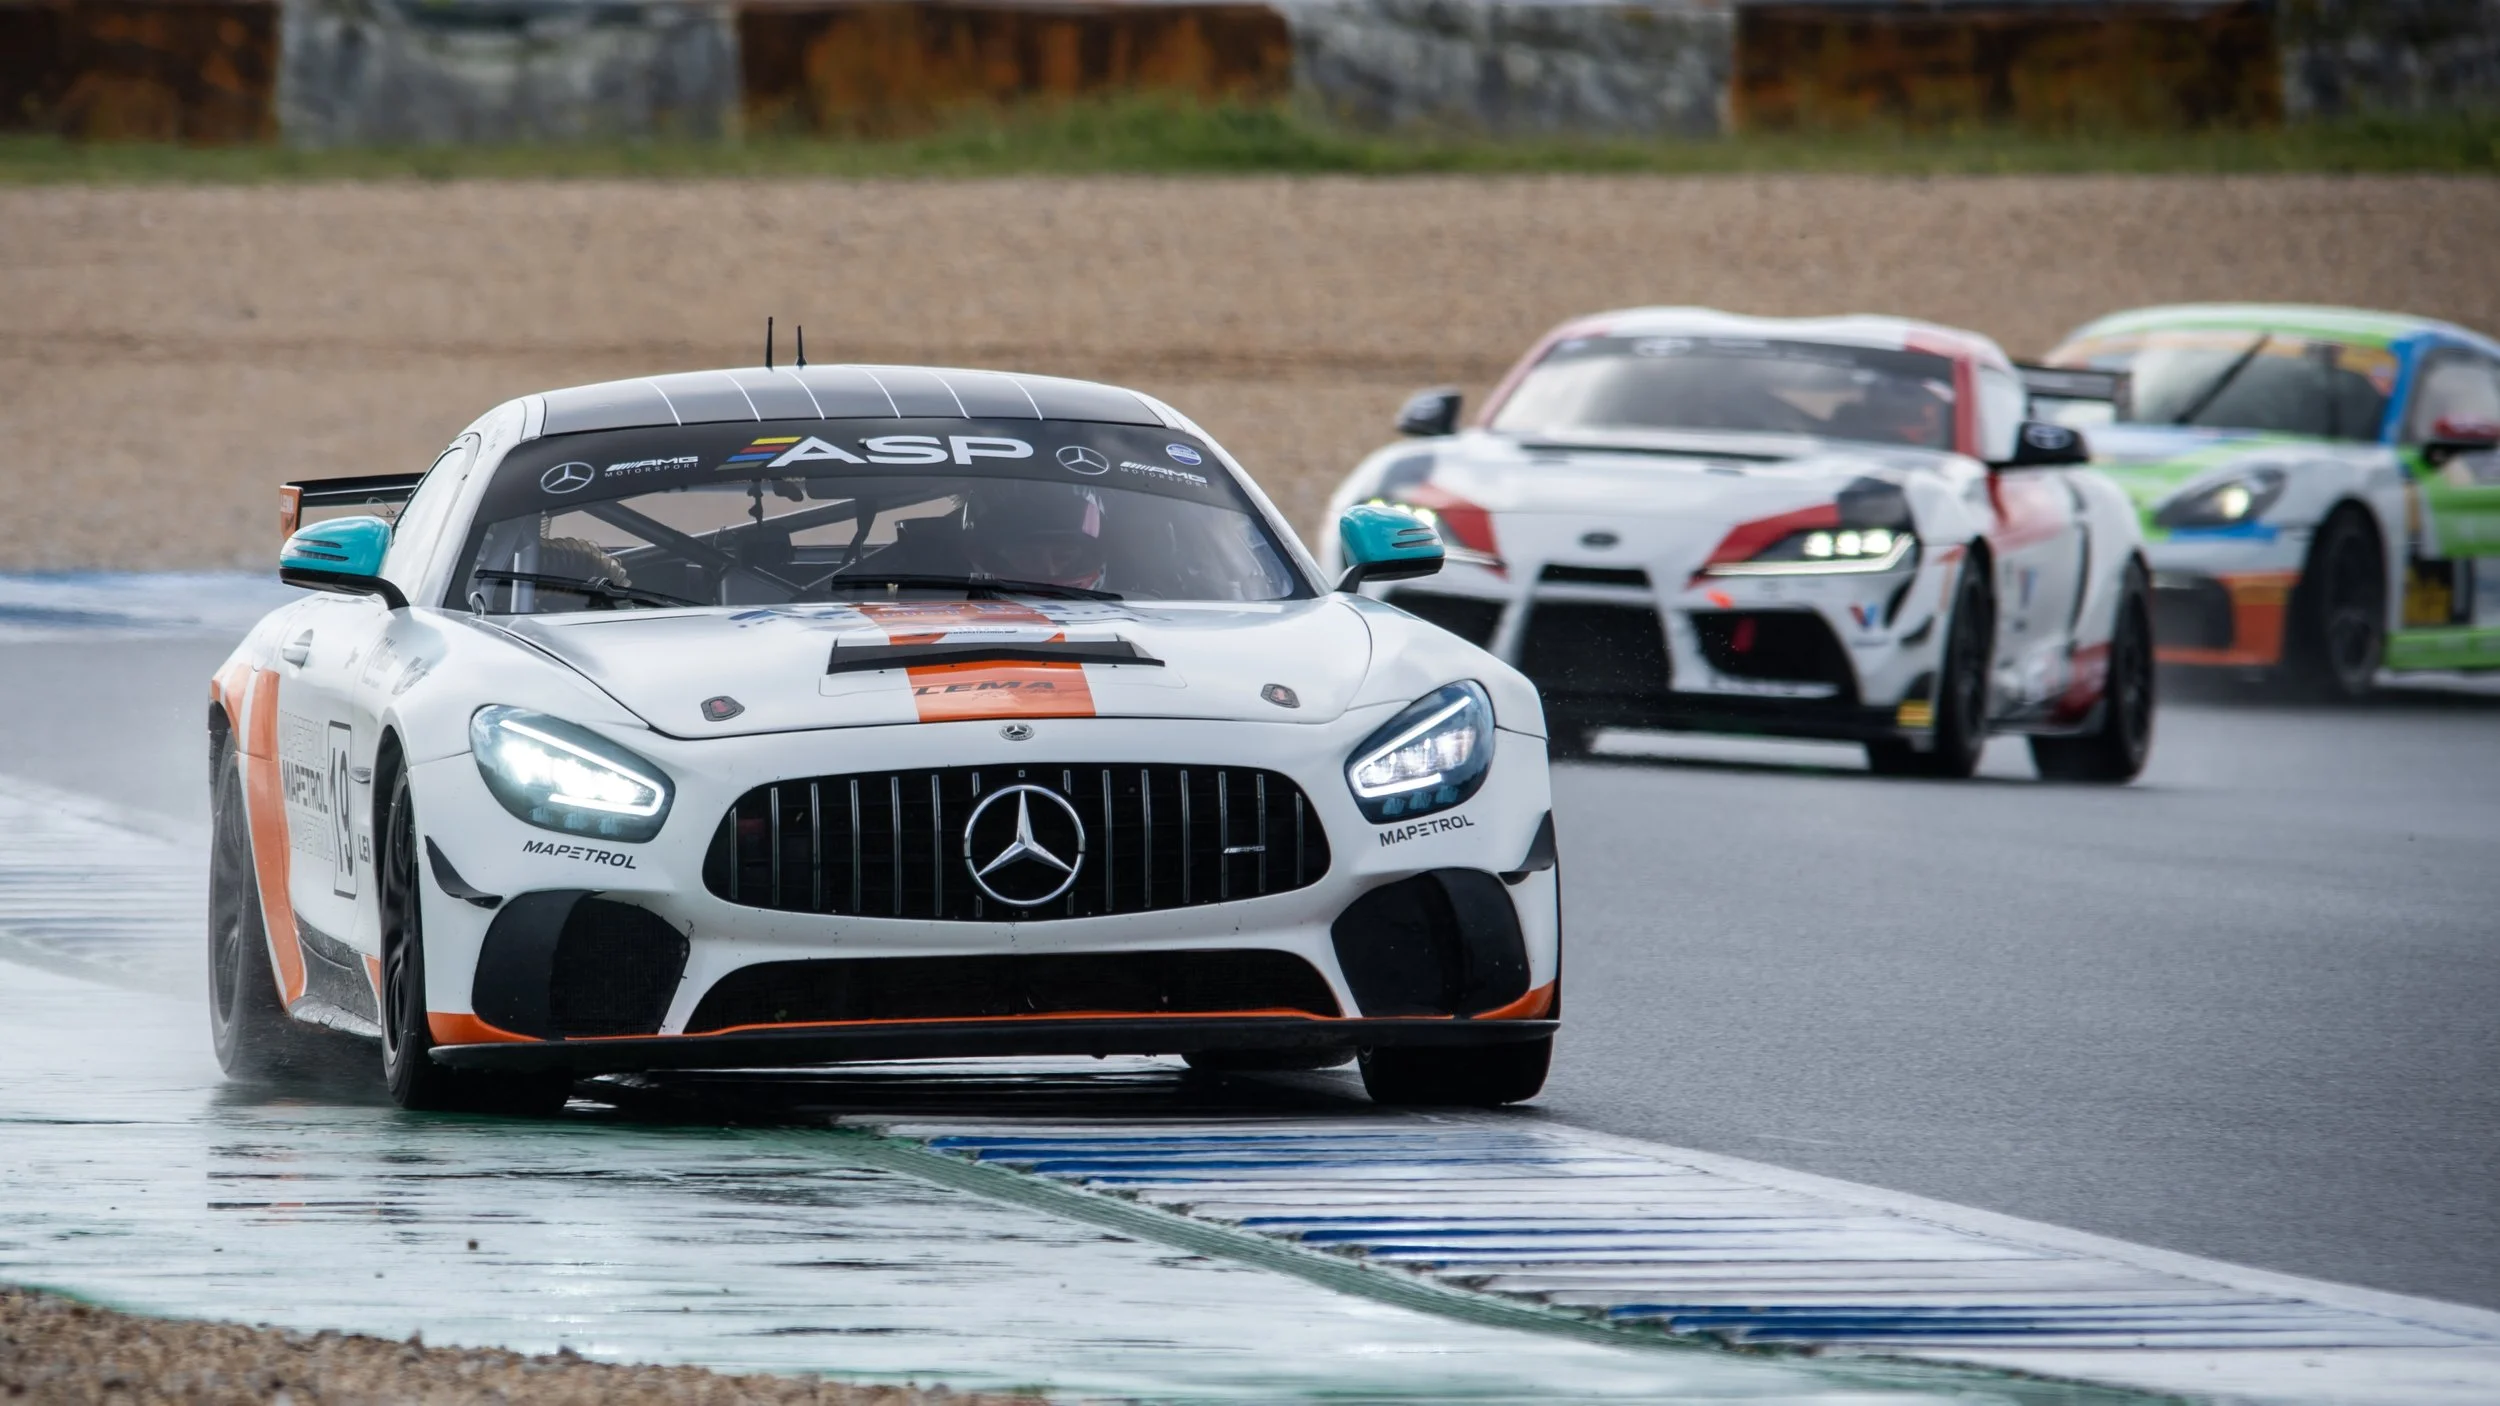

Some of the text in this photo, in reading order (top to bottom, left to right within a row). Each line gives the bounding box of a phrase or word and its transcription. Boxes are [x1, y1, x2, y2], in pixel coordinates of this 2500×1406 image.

[766, 435, 1034, 468] ASP
[604, 463, 699, 478] MOTORSPORT
[1120, 467, 1208, 489] MOTORSPORT
[913, 680, 1056, 696] LEMA
[282, 759, 329, 814] MAPETROL
[330, 747, 353, 877] 19
[1379, 814, 1475, 847] MAPETROL
[522, 839, 637, 870] MAPETROL
